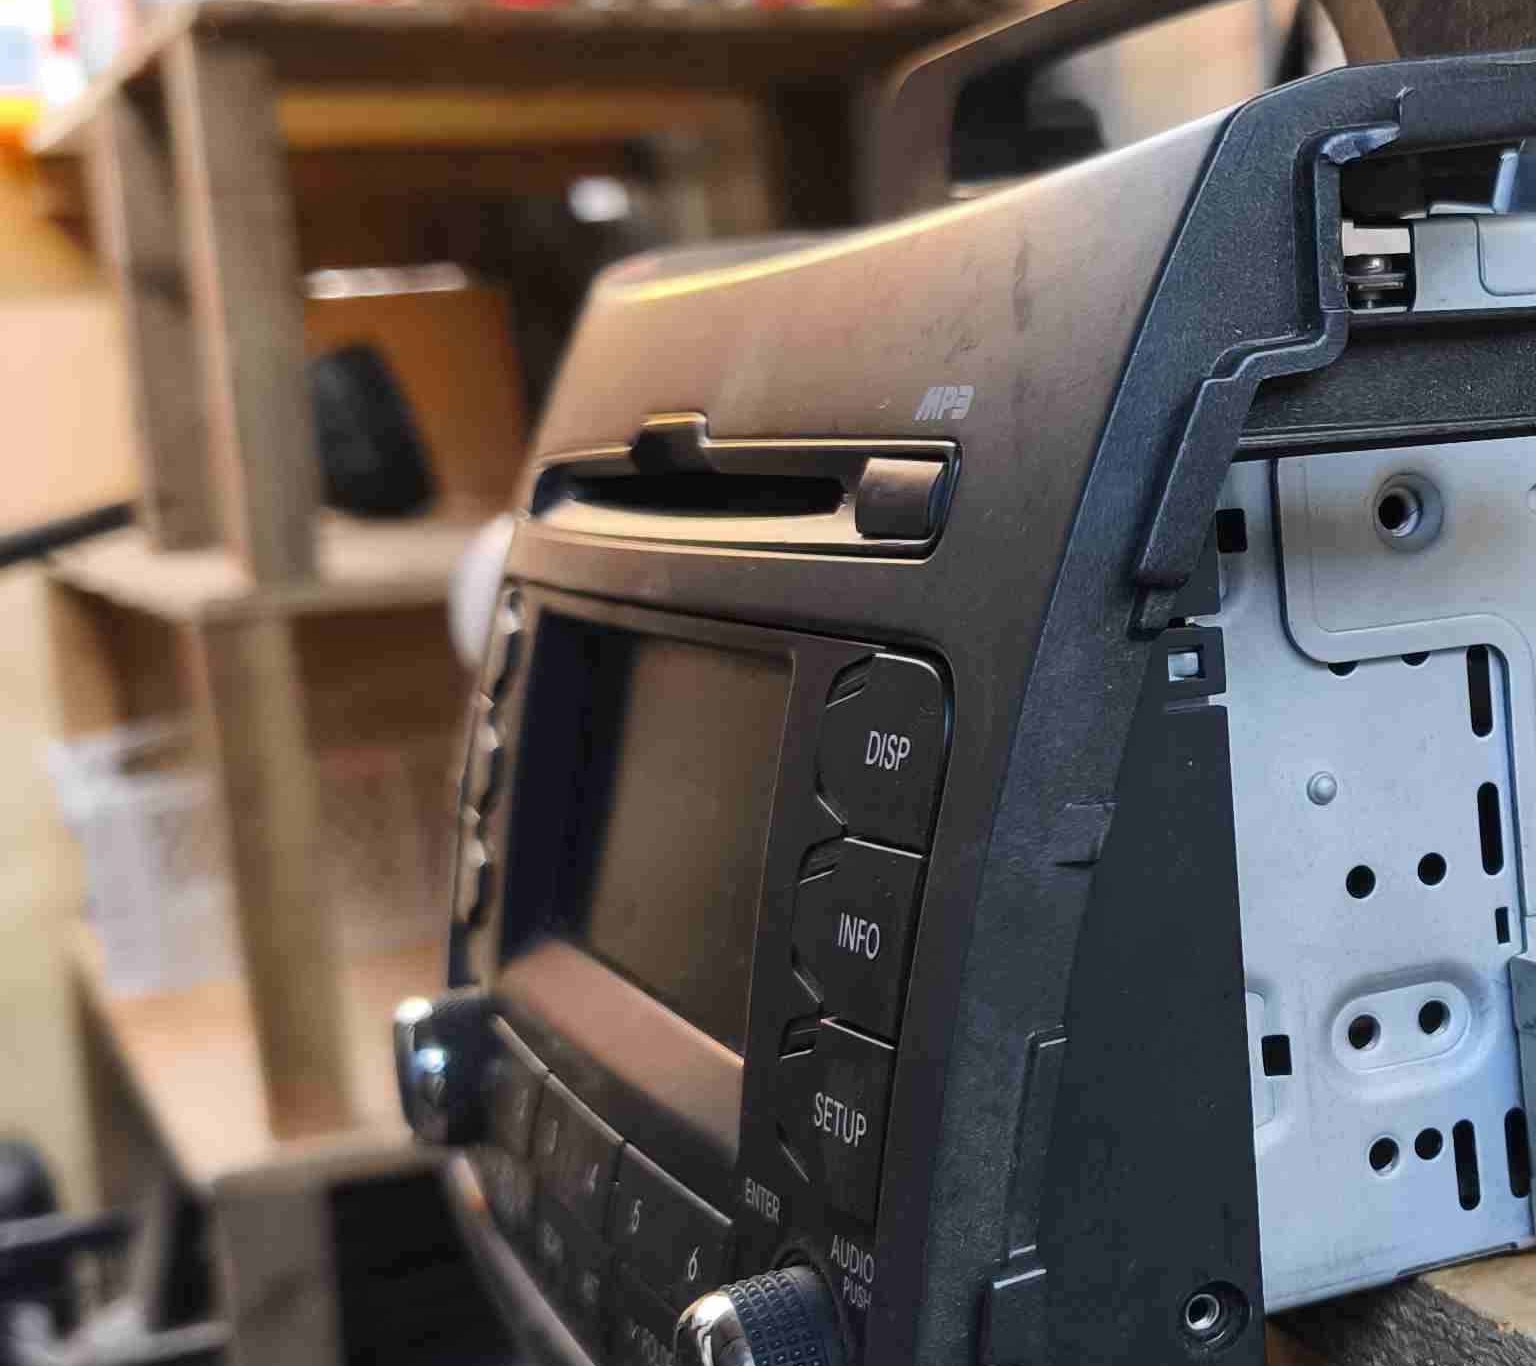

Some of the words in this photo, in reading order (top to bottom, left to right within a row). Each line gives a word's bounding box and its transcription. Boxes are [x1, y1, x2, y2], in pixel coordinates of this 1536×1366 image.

[912, 386, 976, 421] MP3
[864, 730, 911, 771] DISP
[837, 911, 881, 960] INFO
[813, 1091, 868, 1148] SETUP
[630, 1198, 643, 1235] 5
[744, 1176, 781, 1226] ENTER
[687, 1245, 700, 1281] 6
[829, 1234, 875, 1284] AUDIO
[842, 1276, 872, 1311] PUSH
